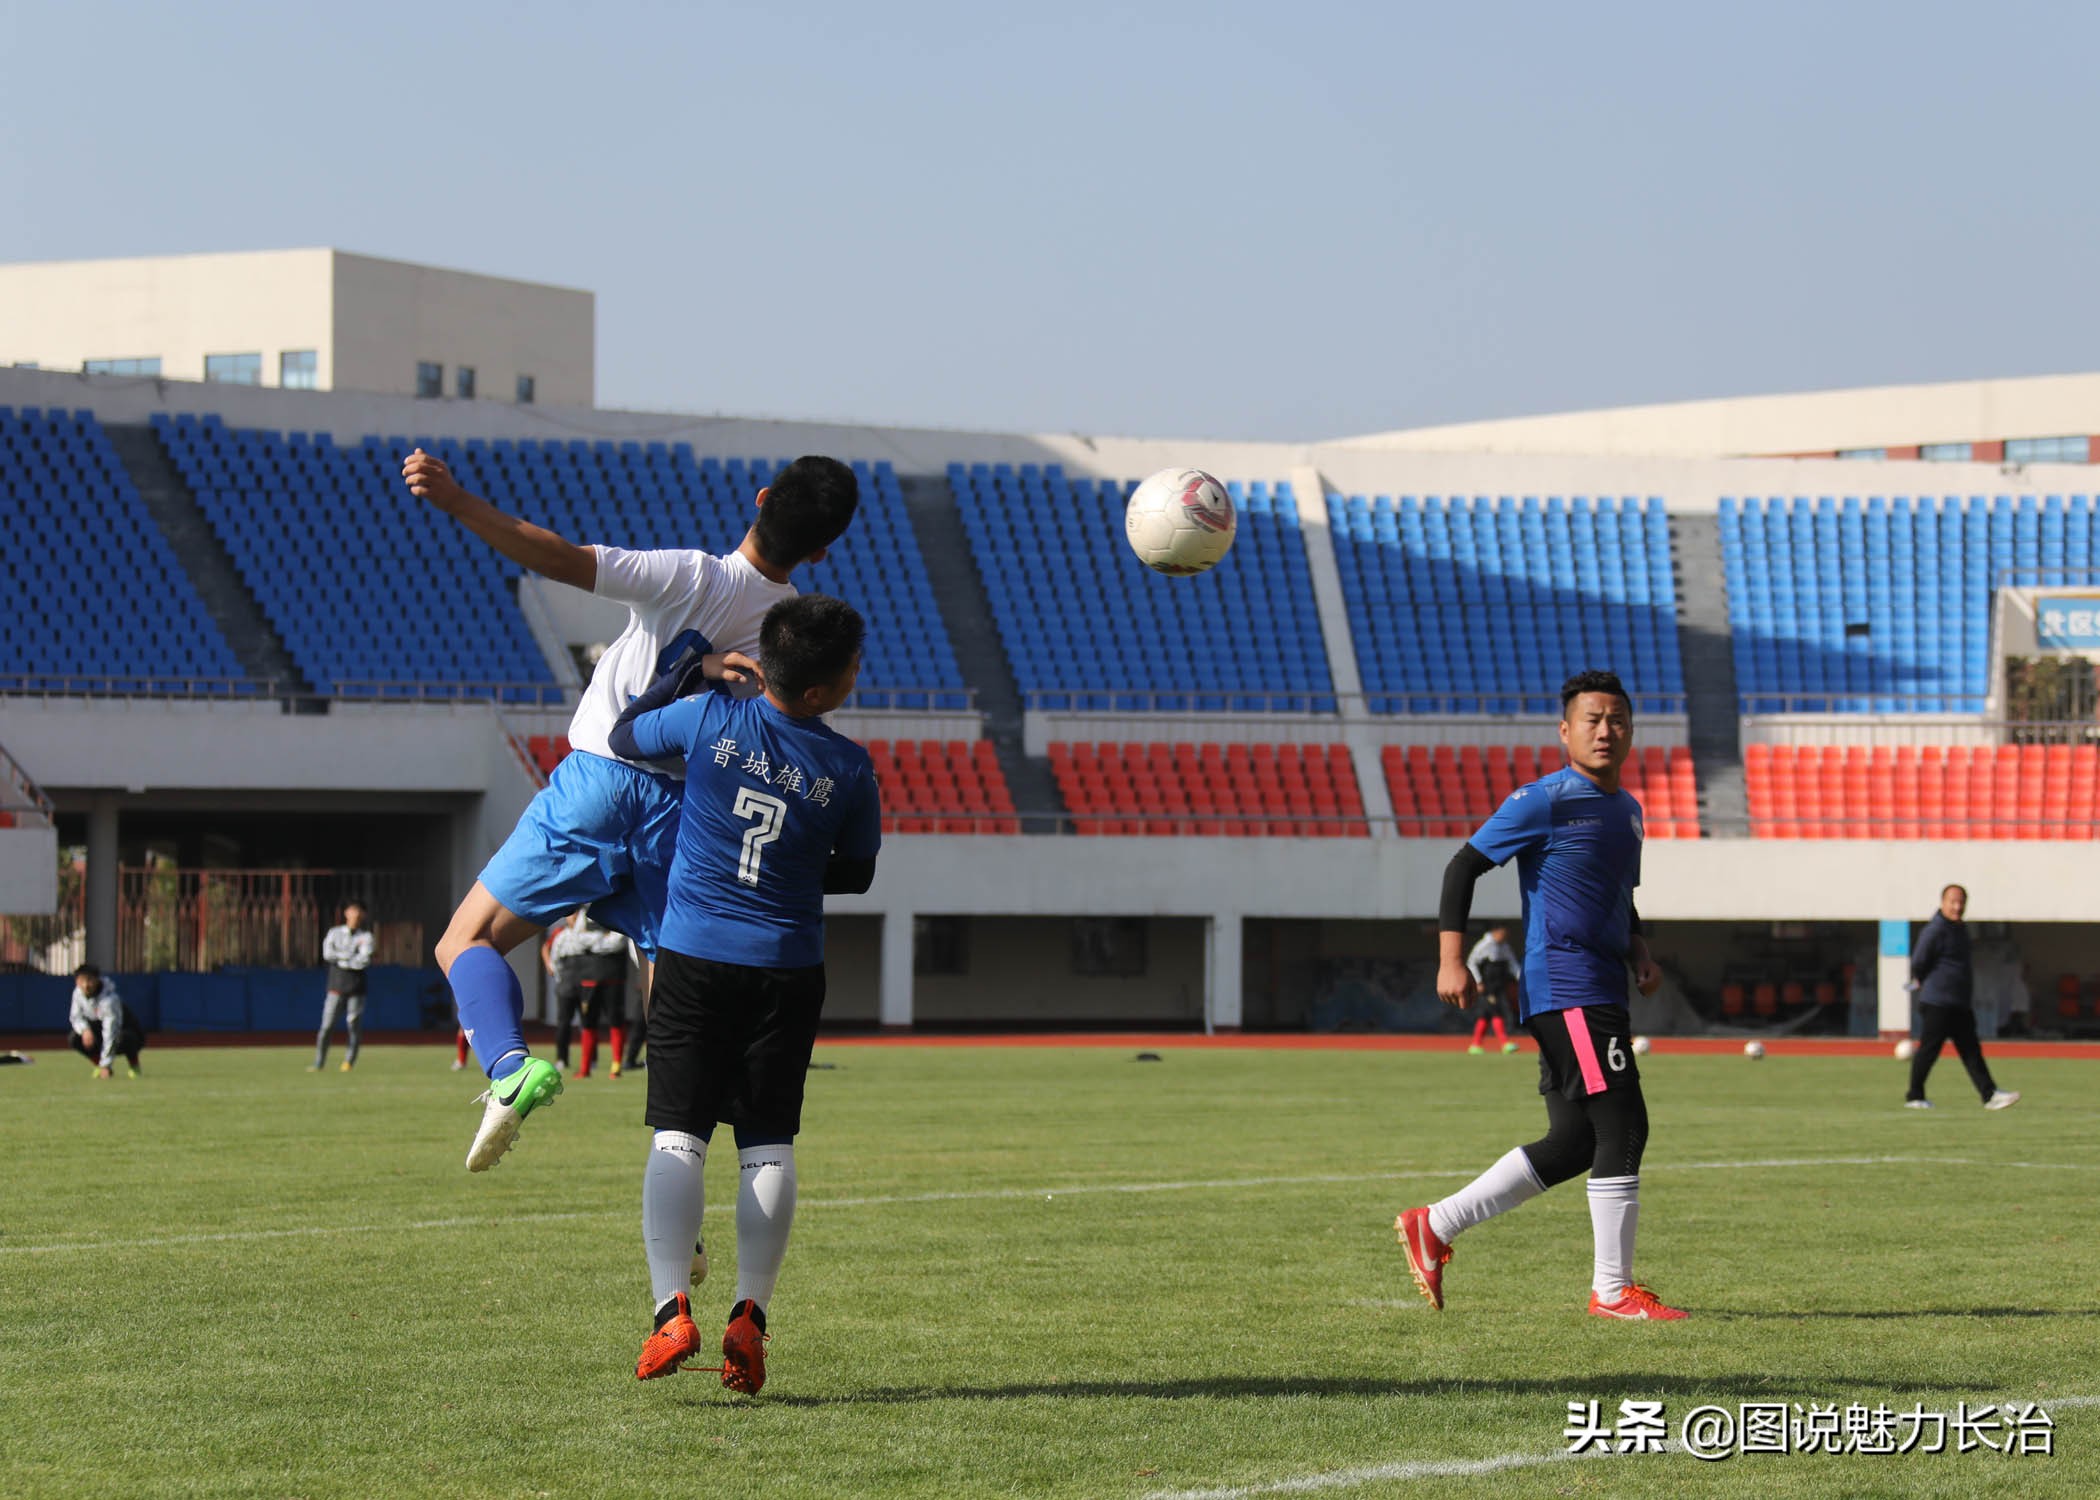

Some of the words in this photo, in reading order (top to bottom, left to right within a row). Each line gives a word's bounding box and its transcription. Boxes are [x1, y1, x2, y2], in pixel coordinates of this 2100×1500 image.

[711, 738, 835, 808] 晋城雄鹰
[732, 786, 788, 888] 7
[1607, 1036, 1627, 1072] 6
[741, 1160, 783, 1170] KELME
